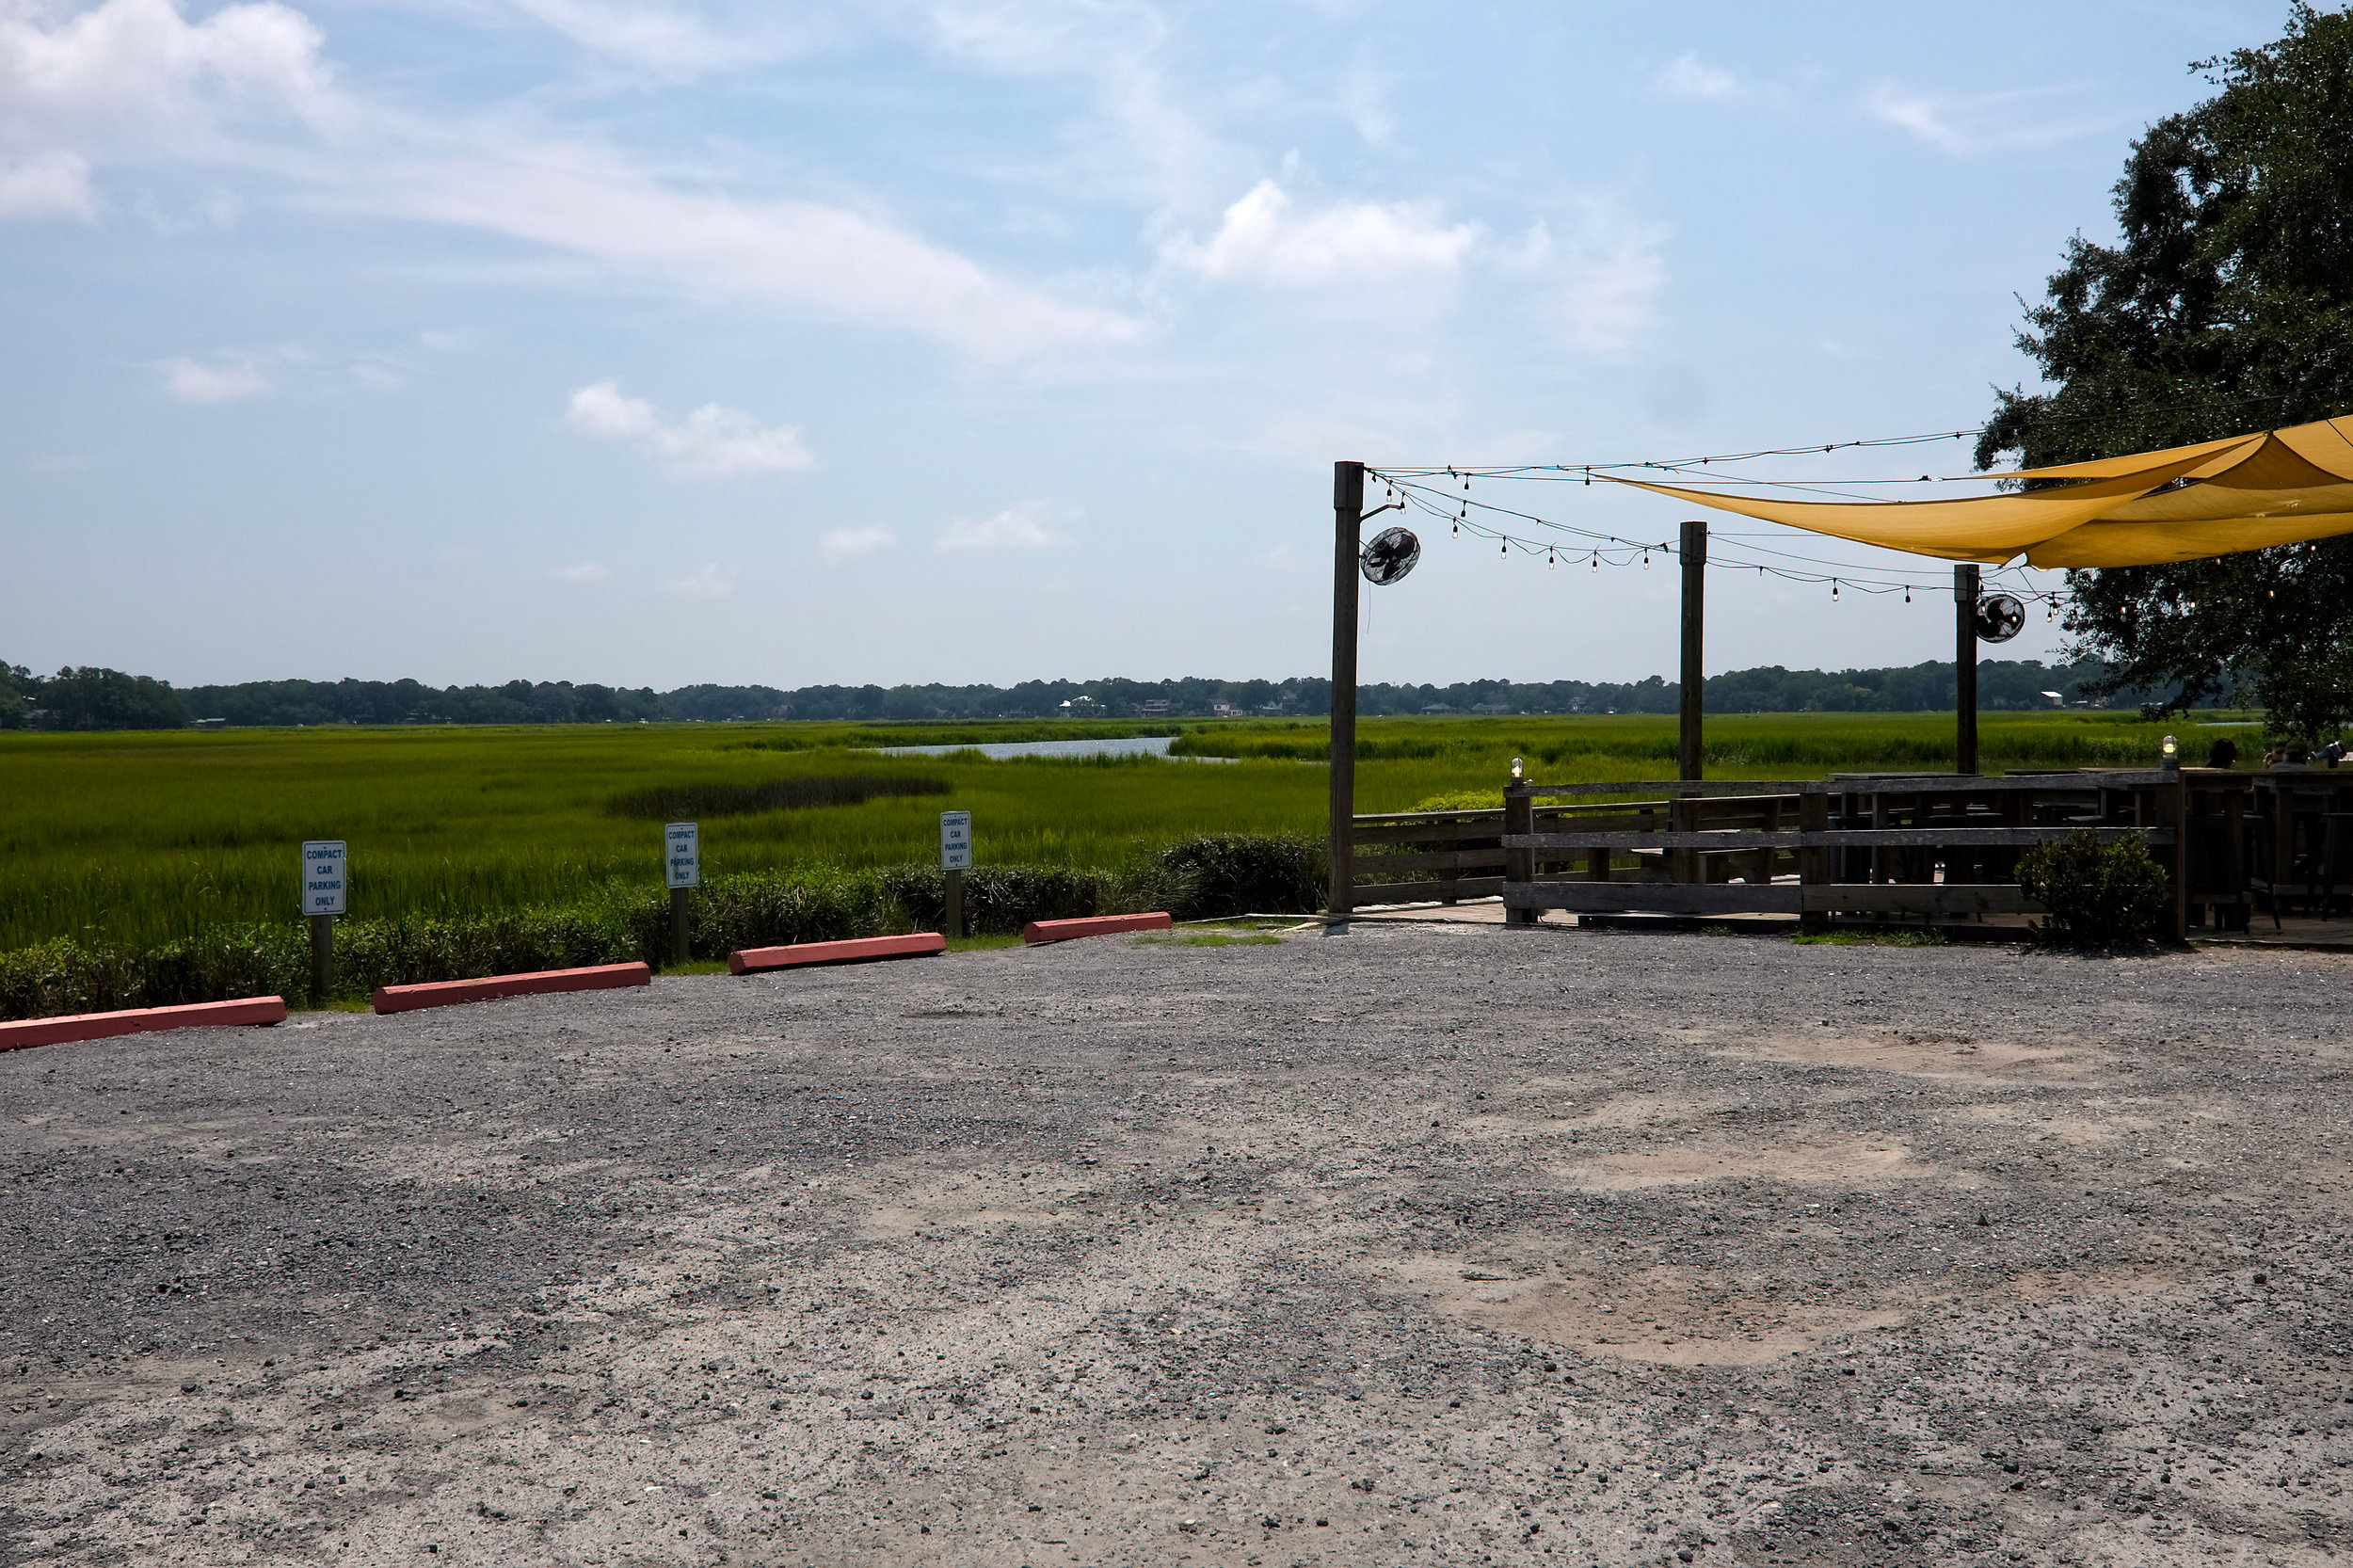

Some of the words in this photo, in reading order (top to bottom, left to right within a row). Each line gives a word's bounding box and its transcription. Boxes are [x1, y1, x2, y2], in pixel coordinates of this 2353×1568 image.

[943, 818, 968, 826] COMPACT
[669, 830, 695, 840] COMPACT
[945, 842, 968, 851] PARKING
[307, 850, 342, 859] COMPACT
[950, 855, 963, 863] ONLY
[670, 857, 694, 866] PARKING
[317, 866, 332, 874] CAR
[675, 872, 689, 880] ONLY
[309, 881, 341, 890] PARKING
[315, 896, 334, 905] ONLY
